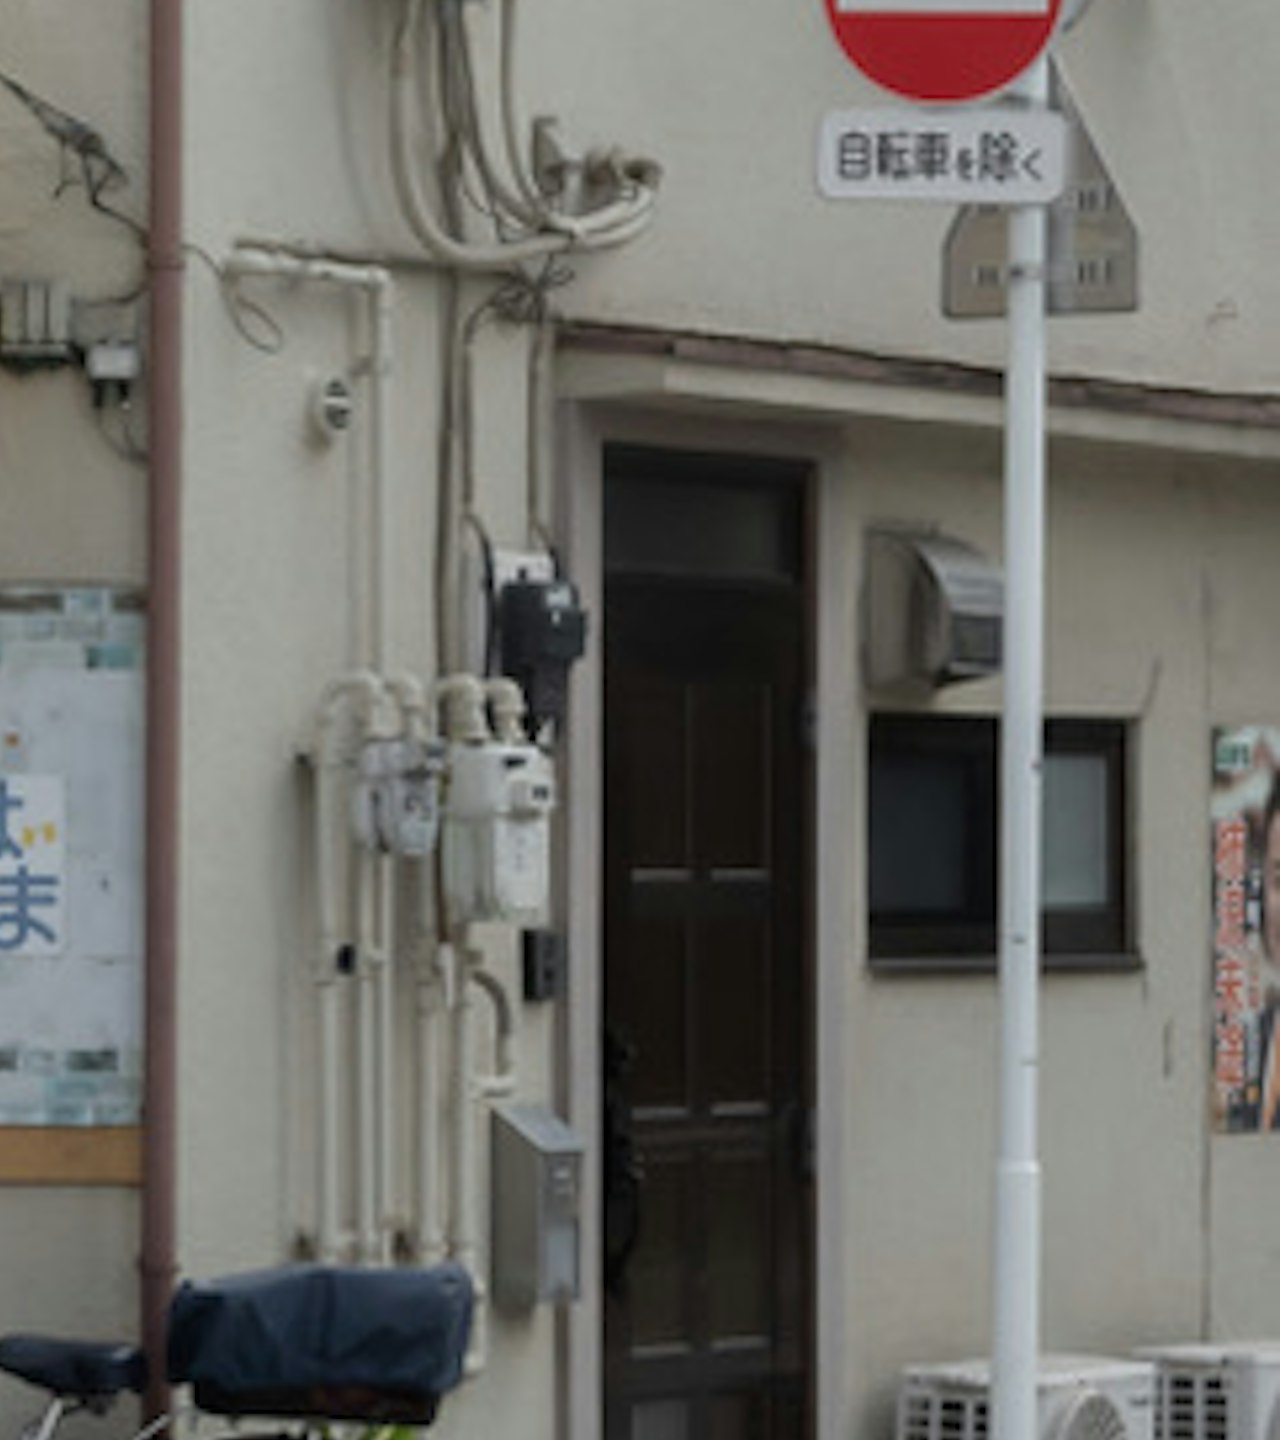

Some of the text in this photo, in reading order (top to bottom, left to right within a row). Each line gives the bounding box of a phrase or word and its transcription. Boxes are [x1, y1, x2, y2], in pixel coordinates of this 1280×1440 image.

[837, 131, 1043, 182] 自転車を除く
